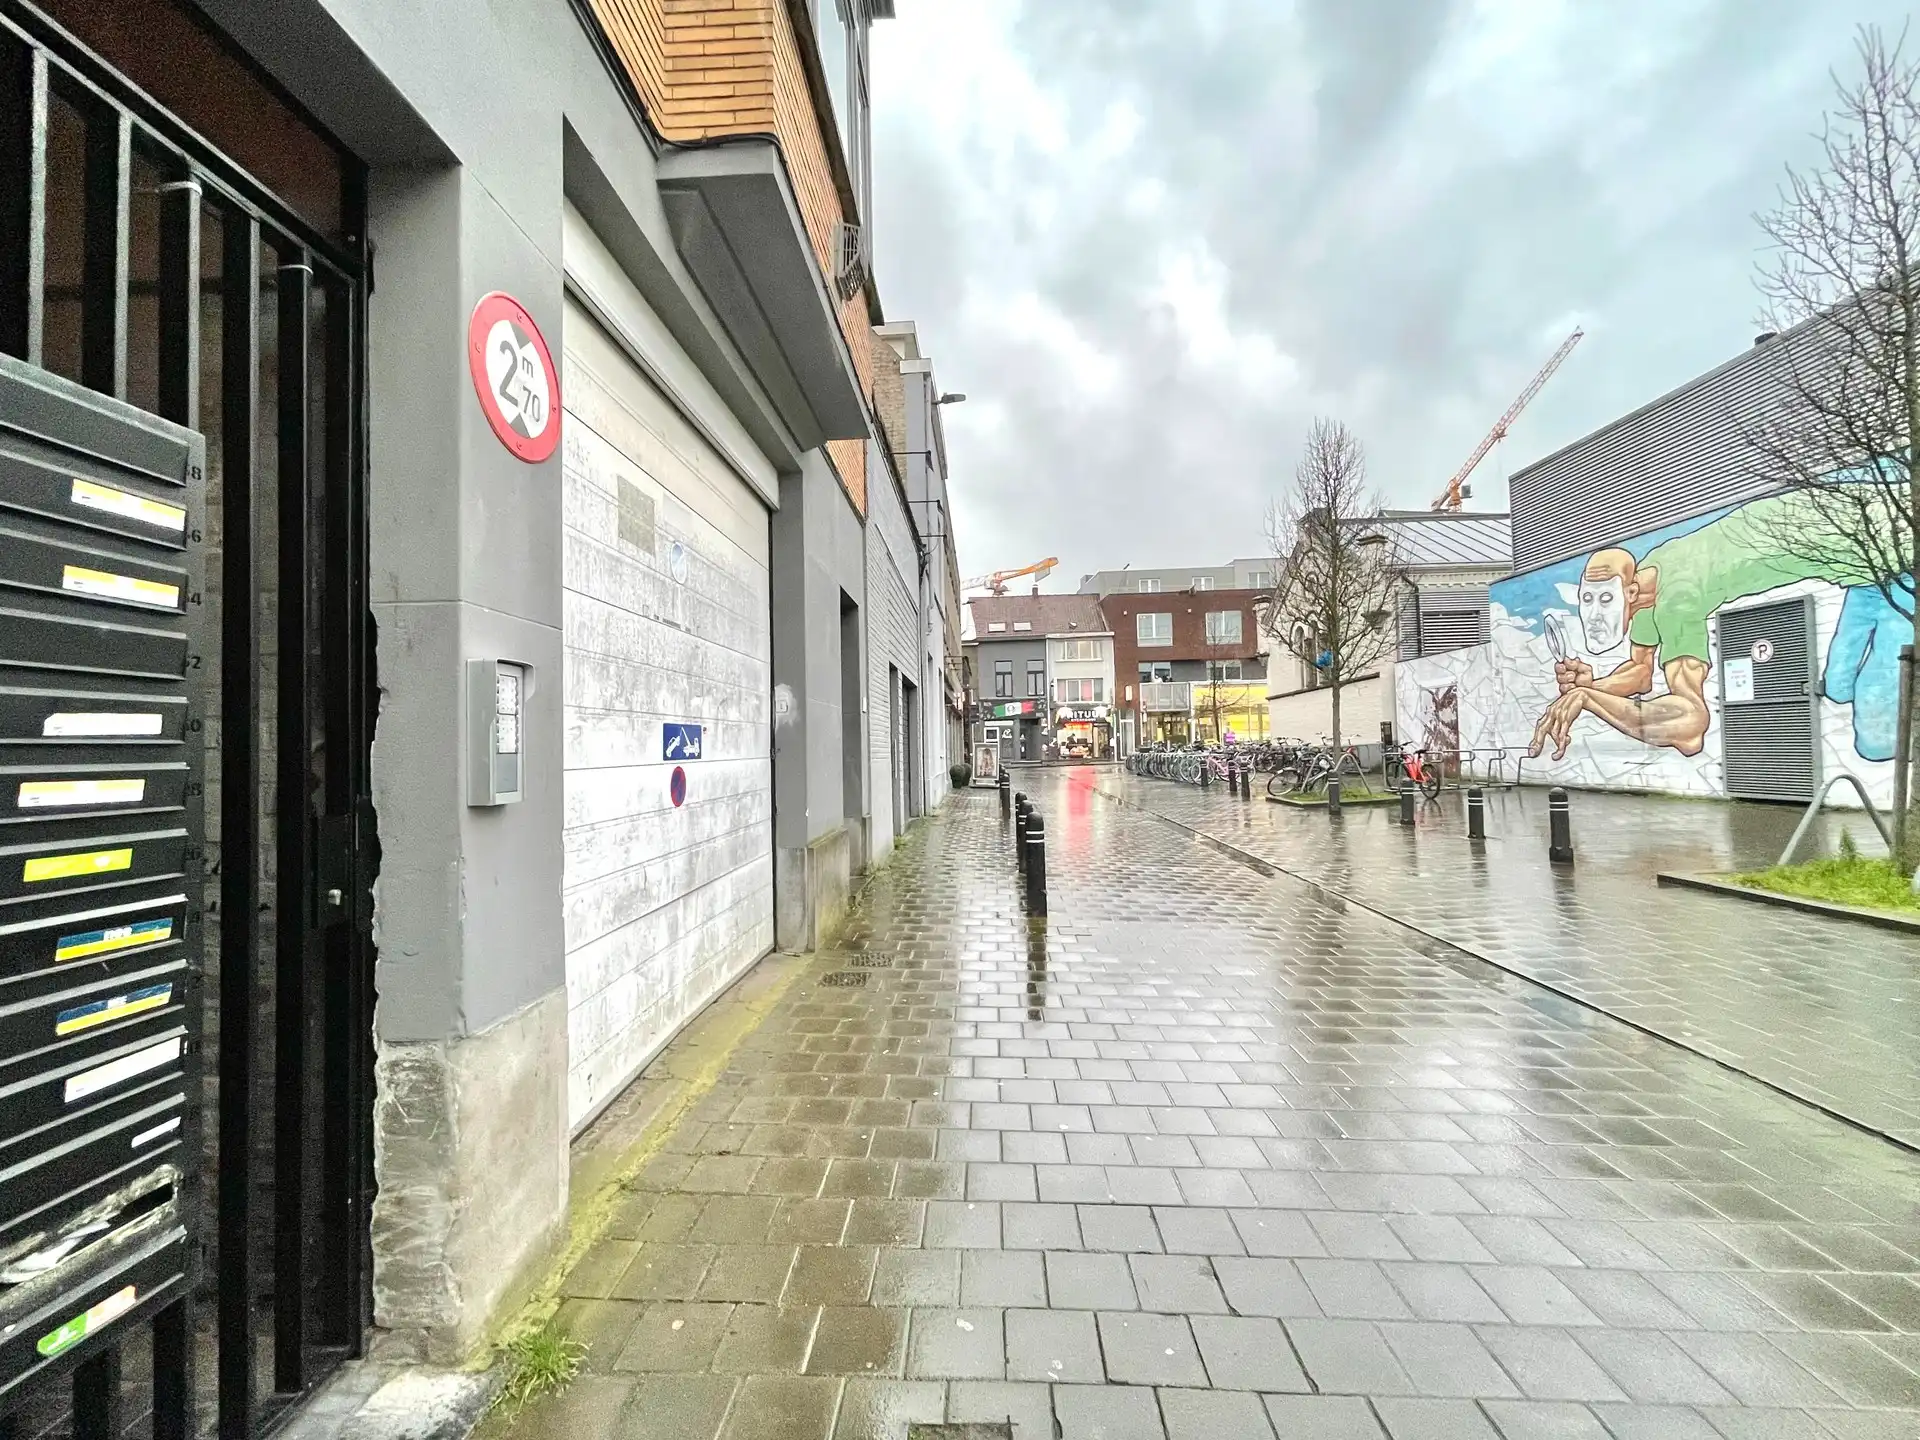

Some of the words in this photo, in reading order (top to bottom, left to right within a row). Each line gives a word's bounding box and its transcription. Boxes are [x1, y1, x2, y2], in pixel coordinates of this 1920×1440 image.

[500, 340, 518, 407] 2
[522, 356, 533, 378] m
[523, 385, 540, 422] 70
